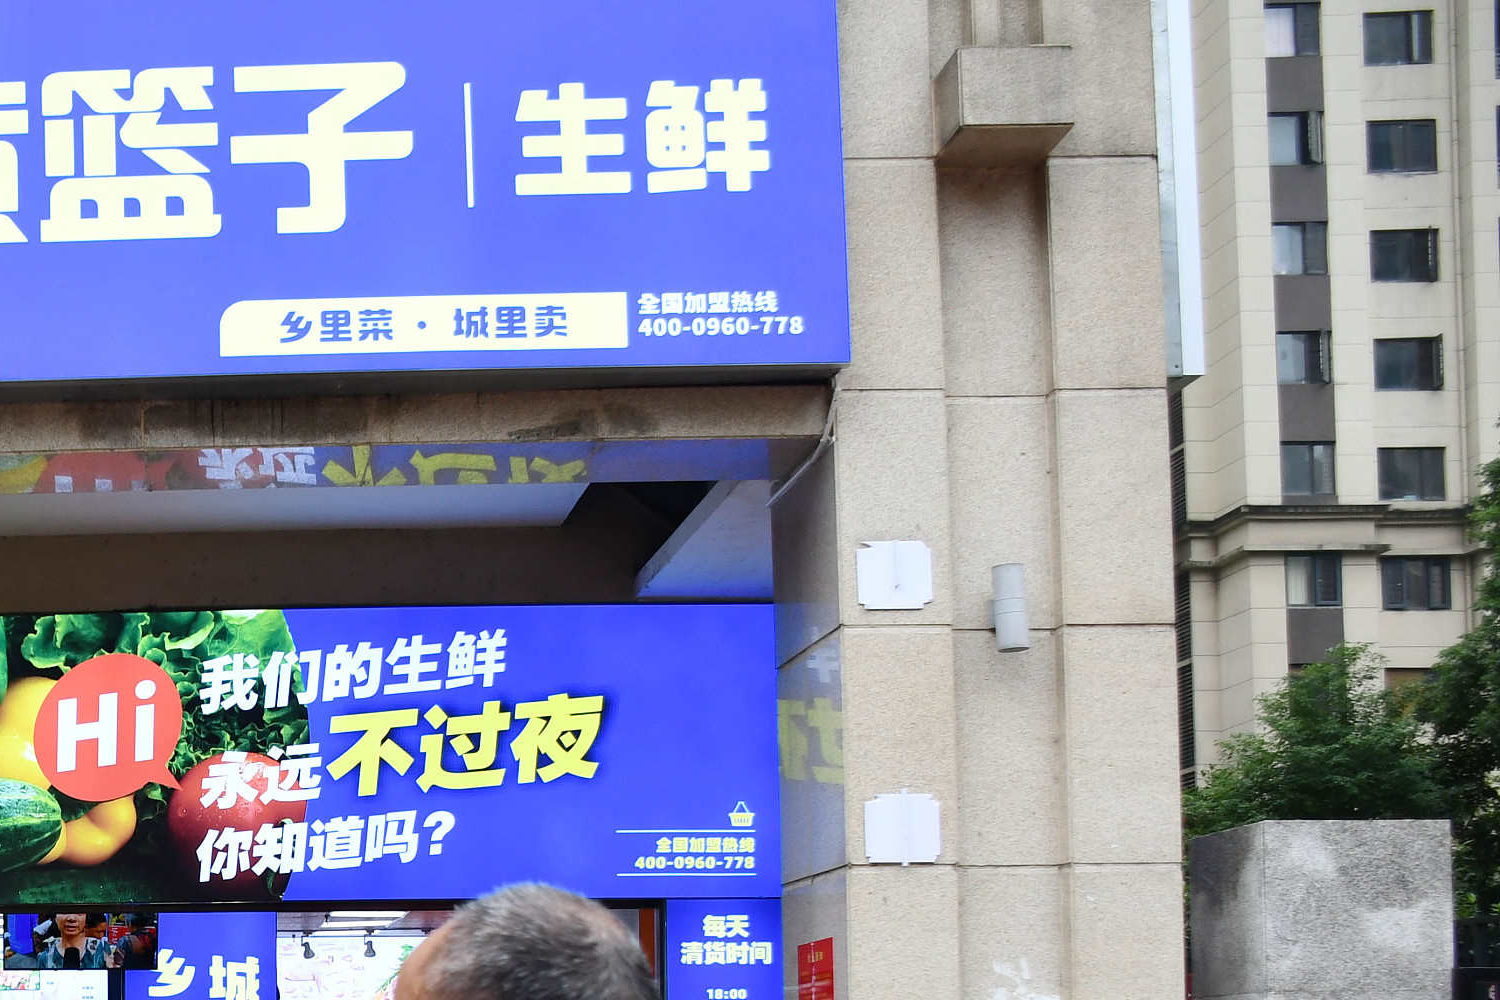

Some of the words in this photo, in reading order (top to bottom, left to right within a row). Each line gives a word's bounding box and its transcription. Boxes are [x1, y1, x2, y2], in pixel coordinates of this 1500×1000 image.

[515, 78, 770, 195] 生鲜
[638, 291, 778, 314] 全国加盟热线
[638, 315, 804, 338] 400-0960-778
[200, 629, 507, 715] 我们的生鲜
[56, 678, 156, 772] Hi
[655, 837, 755, 853] 全国加盟热线
[634, 856, 755, 870] 400-0960-778
[702, 914, 749, 938] 每天
[680, 942, 773, 965] 清货时间
[706, 988, 747, 1000] 18:00
